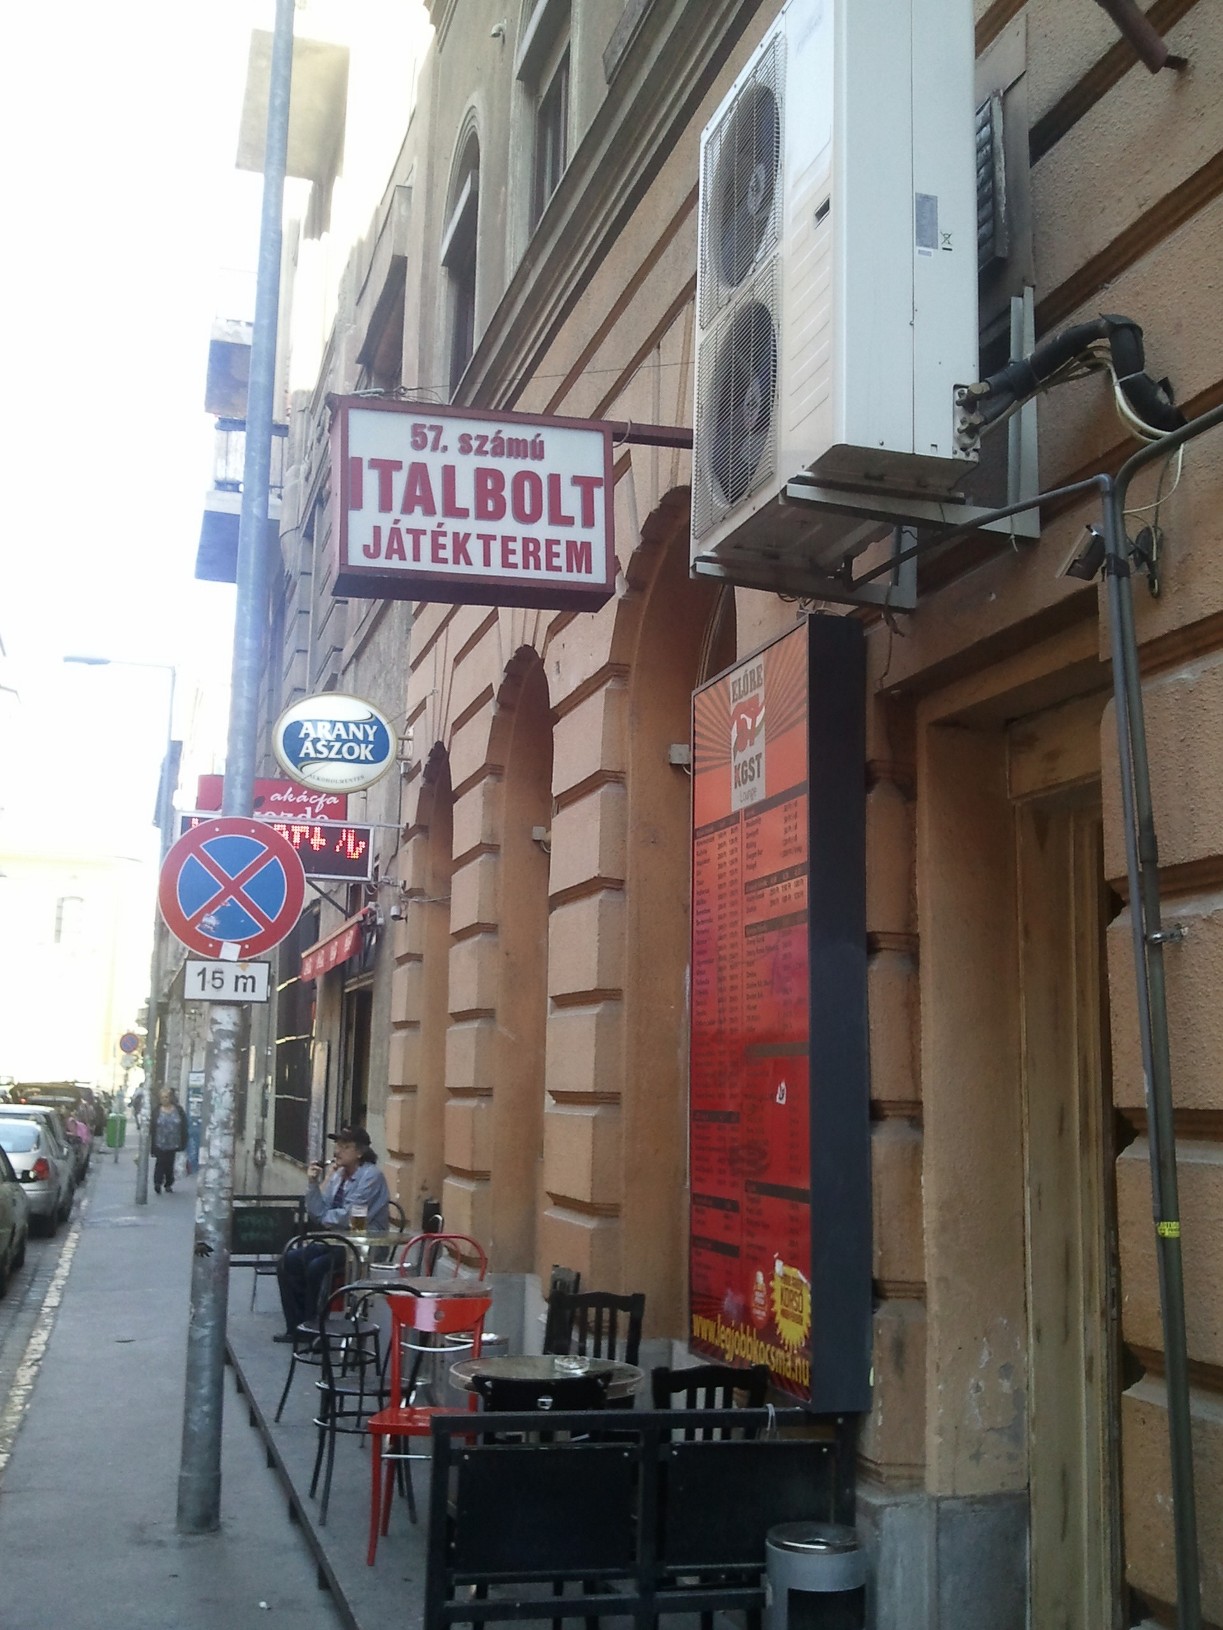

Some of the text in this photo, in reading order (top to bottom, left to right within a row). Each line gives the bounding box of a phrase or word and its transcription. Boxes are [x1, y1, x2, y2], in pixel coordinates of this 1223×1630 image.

[410, 422, 545, 461] 57. számú
[349, 456, 604, 529] ITALBOLT
[362, 518, 593, 575] JÁTÉKTEREM
[298, 721, 378, 742] ARANY
[299, 737, 375, 761] ÁSZOK
[734, 752, 762, 789] KGST
[269, 786, 340, 813] akácfa
[197, 966, 257, 993] 15 m
